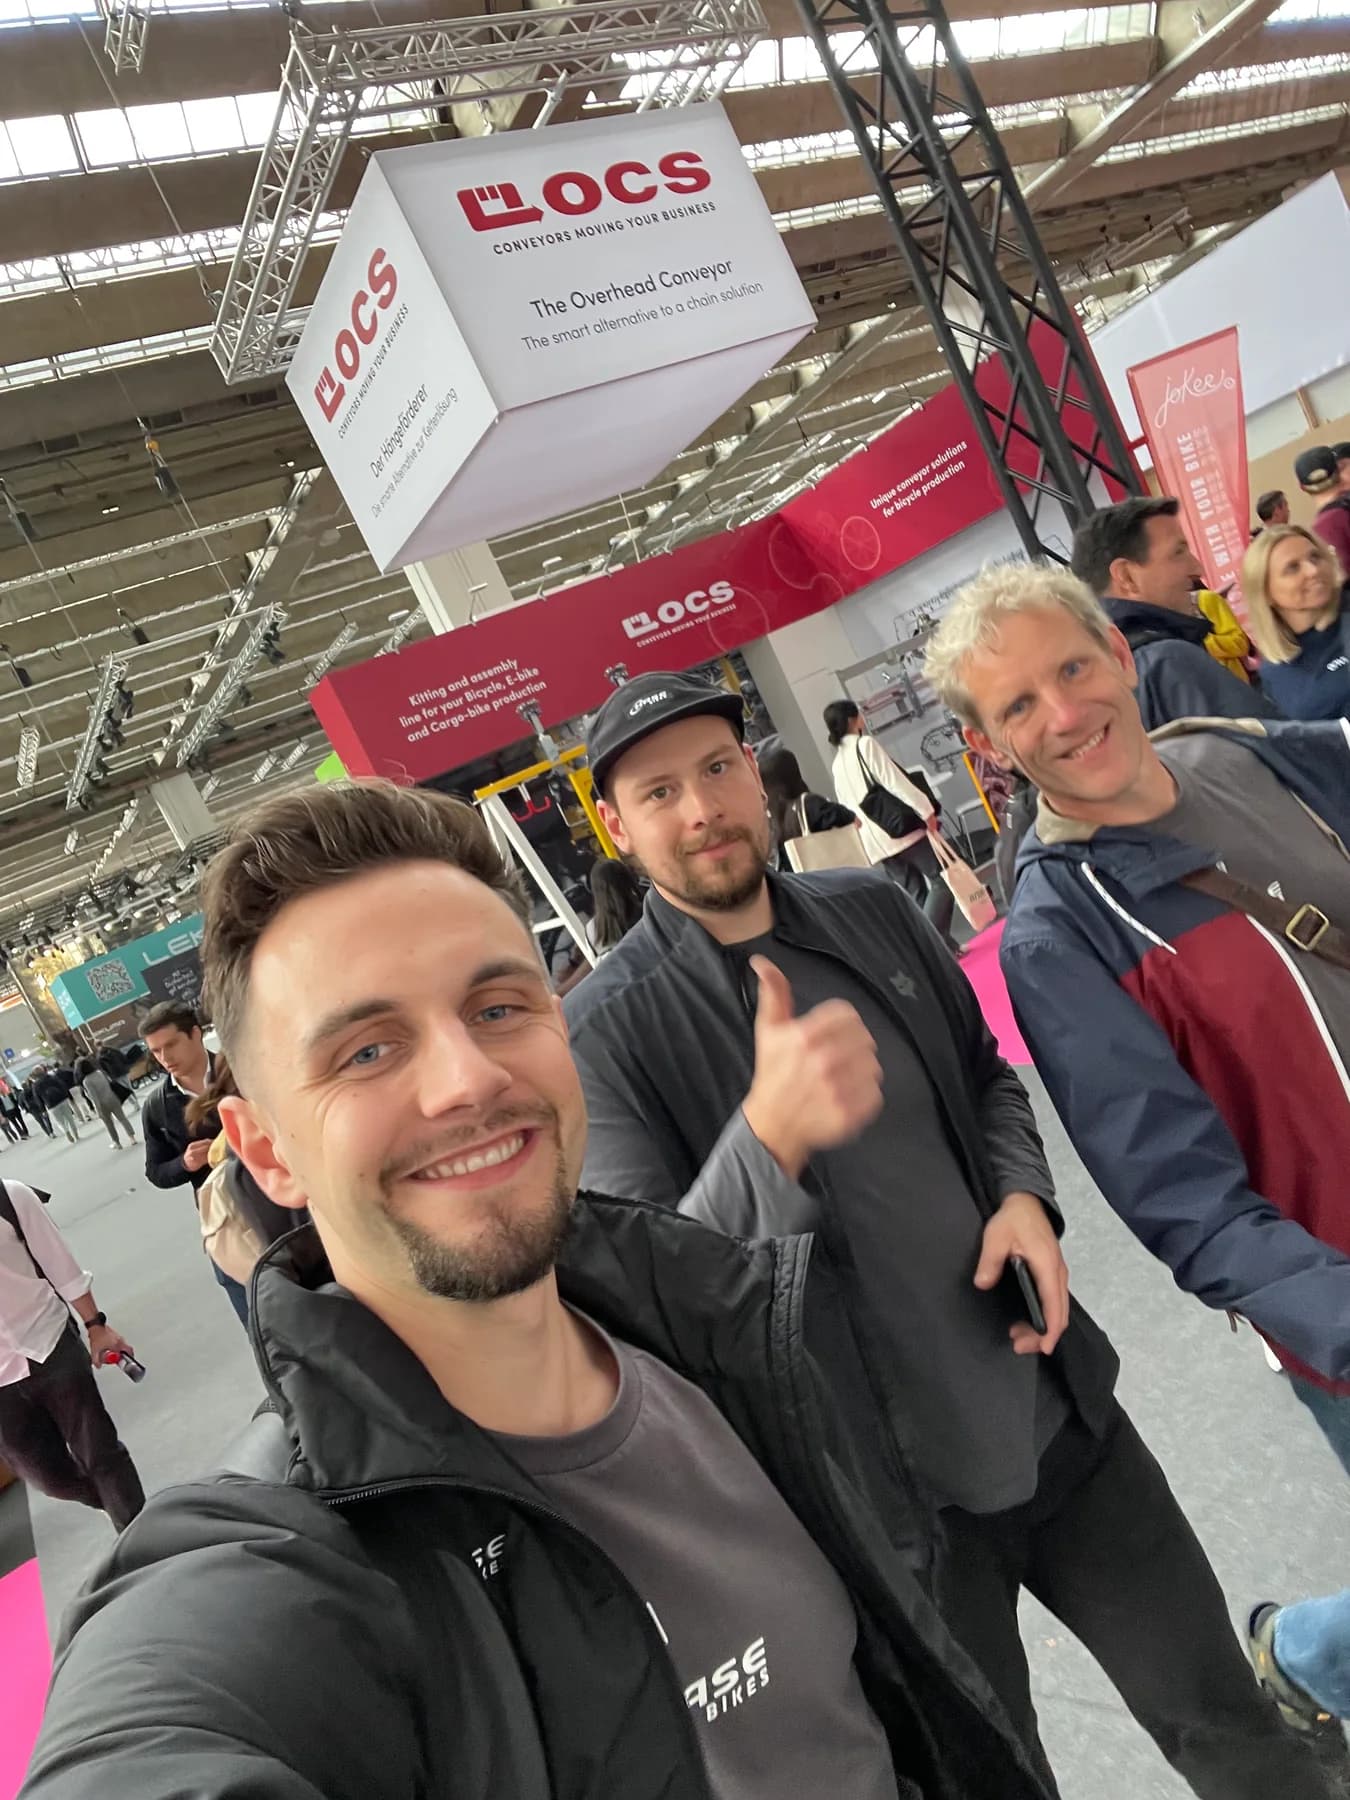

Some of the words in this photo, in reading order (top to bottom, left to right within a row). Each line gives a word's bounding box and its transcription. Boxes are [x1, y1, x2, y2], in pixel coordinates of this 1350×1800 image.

[457, 151, 711, 232] LOCS
[493, 231, 571, 254] CONVEYORS
[576, 219, 624, 239] MOVING
[626, 212, 659, 229] YOUR
[662, 201, 716, 221] BUSINESS
[521, 336, 550, 351] The
[552, 323, 591, 344] smart
[593, 308, 658, 335] alternative
[660, 302, 674, 317] to
[676, 303, 685, 313] a
[687, 293, 720, 312] chain
[720, 281, 764, 301] solution
[529, 299, 567, 318] The
[570, 274, 656, 309] Overhead
[659, 259, 733, 288] Conveyor
[338, 397, 361, 439] CONVEYORS
[359, 368, 376, 400] MOVING
[373, 344, 388, 370] YOUR
[386, 303, 409, 348] BUSINESS
[370, 456, 384, 478] Der
[870, 488, 897, 509] Unique
[896, 464, 930, 492] conveyor
[930, 441, 968, 470] solutions
[1177, 431, 1200, 473] BIKE
[883, 505, 895, 518] for
[894, 488, 921, 511] bicycle
[921, 460, 965, 496] production
[622, 580, 735, 639] LOCS
[399, 714, 422, 728] line
[422, 705, 439, 719] for
[440, 697, 464, 715] your
[464, 680, 506, 703] Bicycle,
[505, 667, 539, 686] E-bike
[407, 725, 429, 743] and
[430, 702, 491, 733] Cargo-bike
[492, 681, 547, 711] production
[408, 686, 448, 707] Kitting
[448, 676, 469, 692] and
[470, 658, 518, 684] assembly
[142, 930, 204, 966] LEK
[684, 1636, 767, 1709] ASE
[706, 1667, 769, 1723] BIKES
